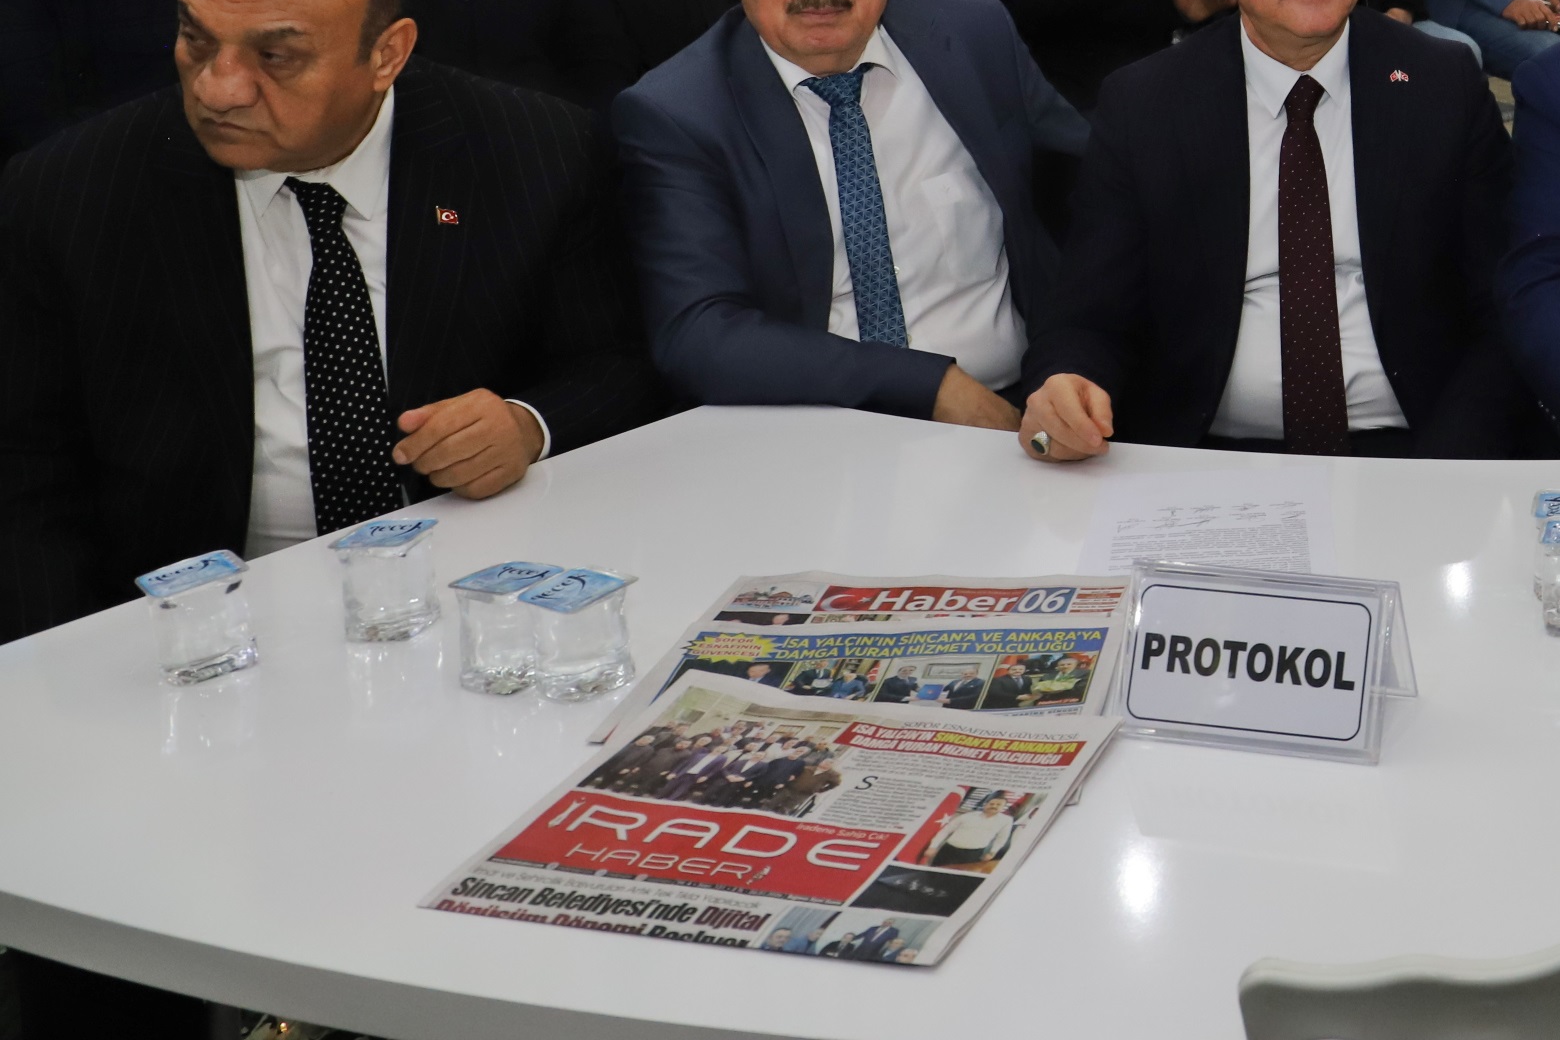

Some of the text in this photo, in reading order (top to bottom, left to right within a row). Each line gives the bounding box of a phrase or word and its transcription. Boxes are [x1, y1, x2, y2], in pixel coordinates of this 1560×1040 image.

[869, 589, 1018, 612] Haber
[1016, 588, 1070, 613] 06
[983, 631, 1002, 642] VE
[1005, 630, 1102, 642] ANKARA'YA
[776, 639, 1075, 660] DAMGA VURAN HİZMET YOLCULUĞU
[1141, 632, 1355, 691] PROTOKOL
[991, 739, 1008, 750] VE
[854, 775, 878, 791] S
[451, 876, 534, 904] Sincan
[694, 905, 772, 933] Dijital
